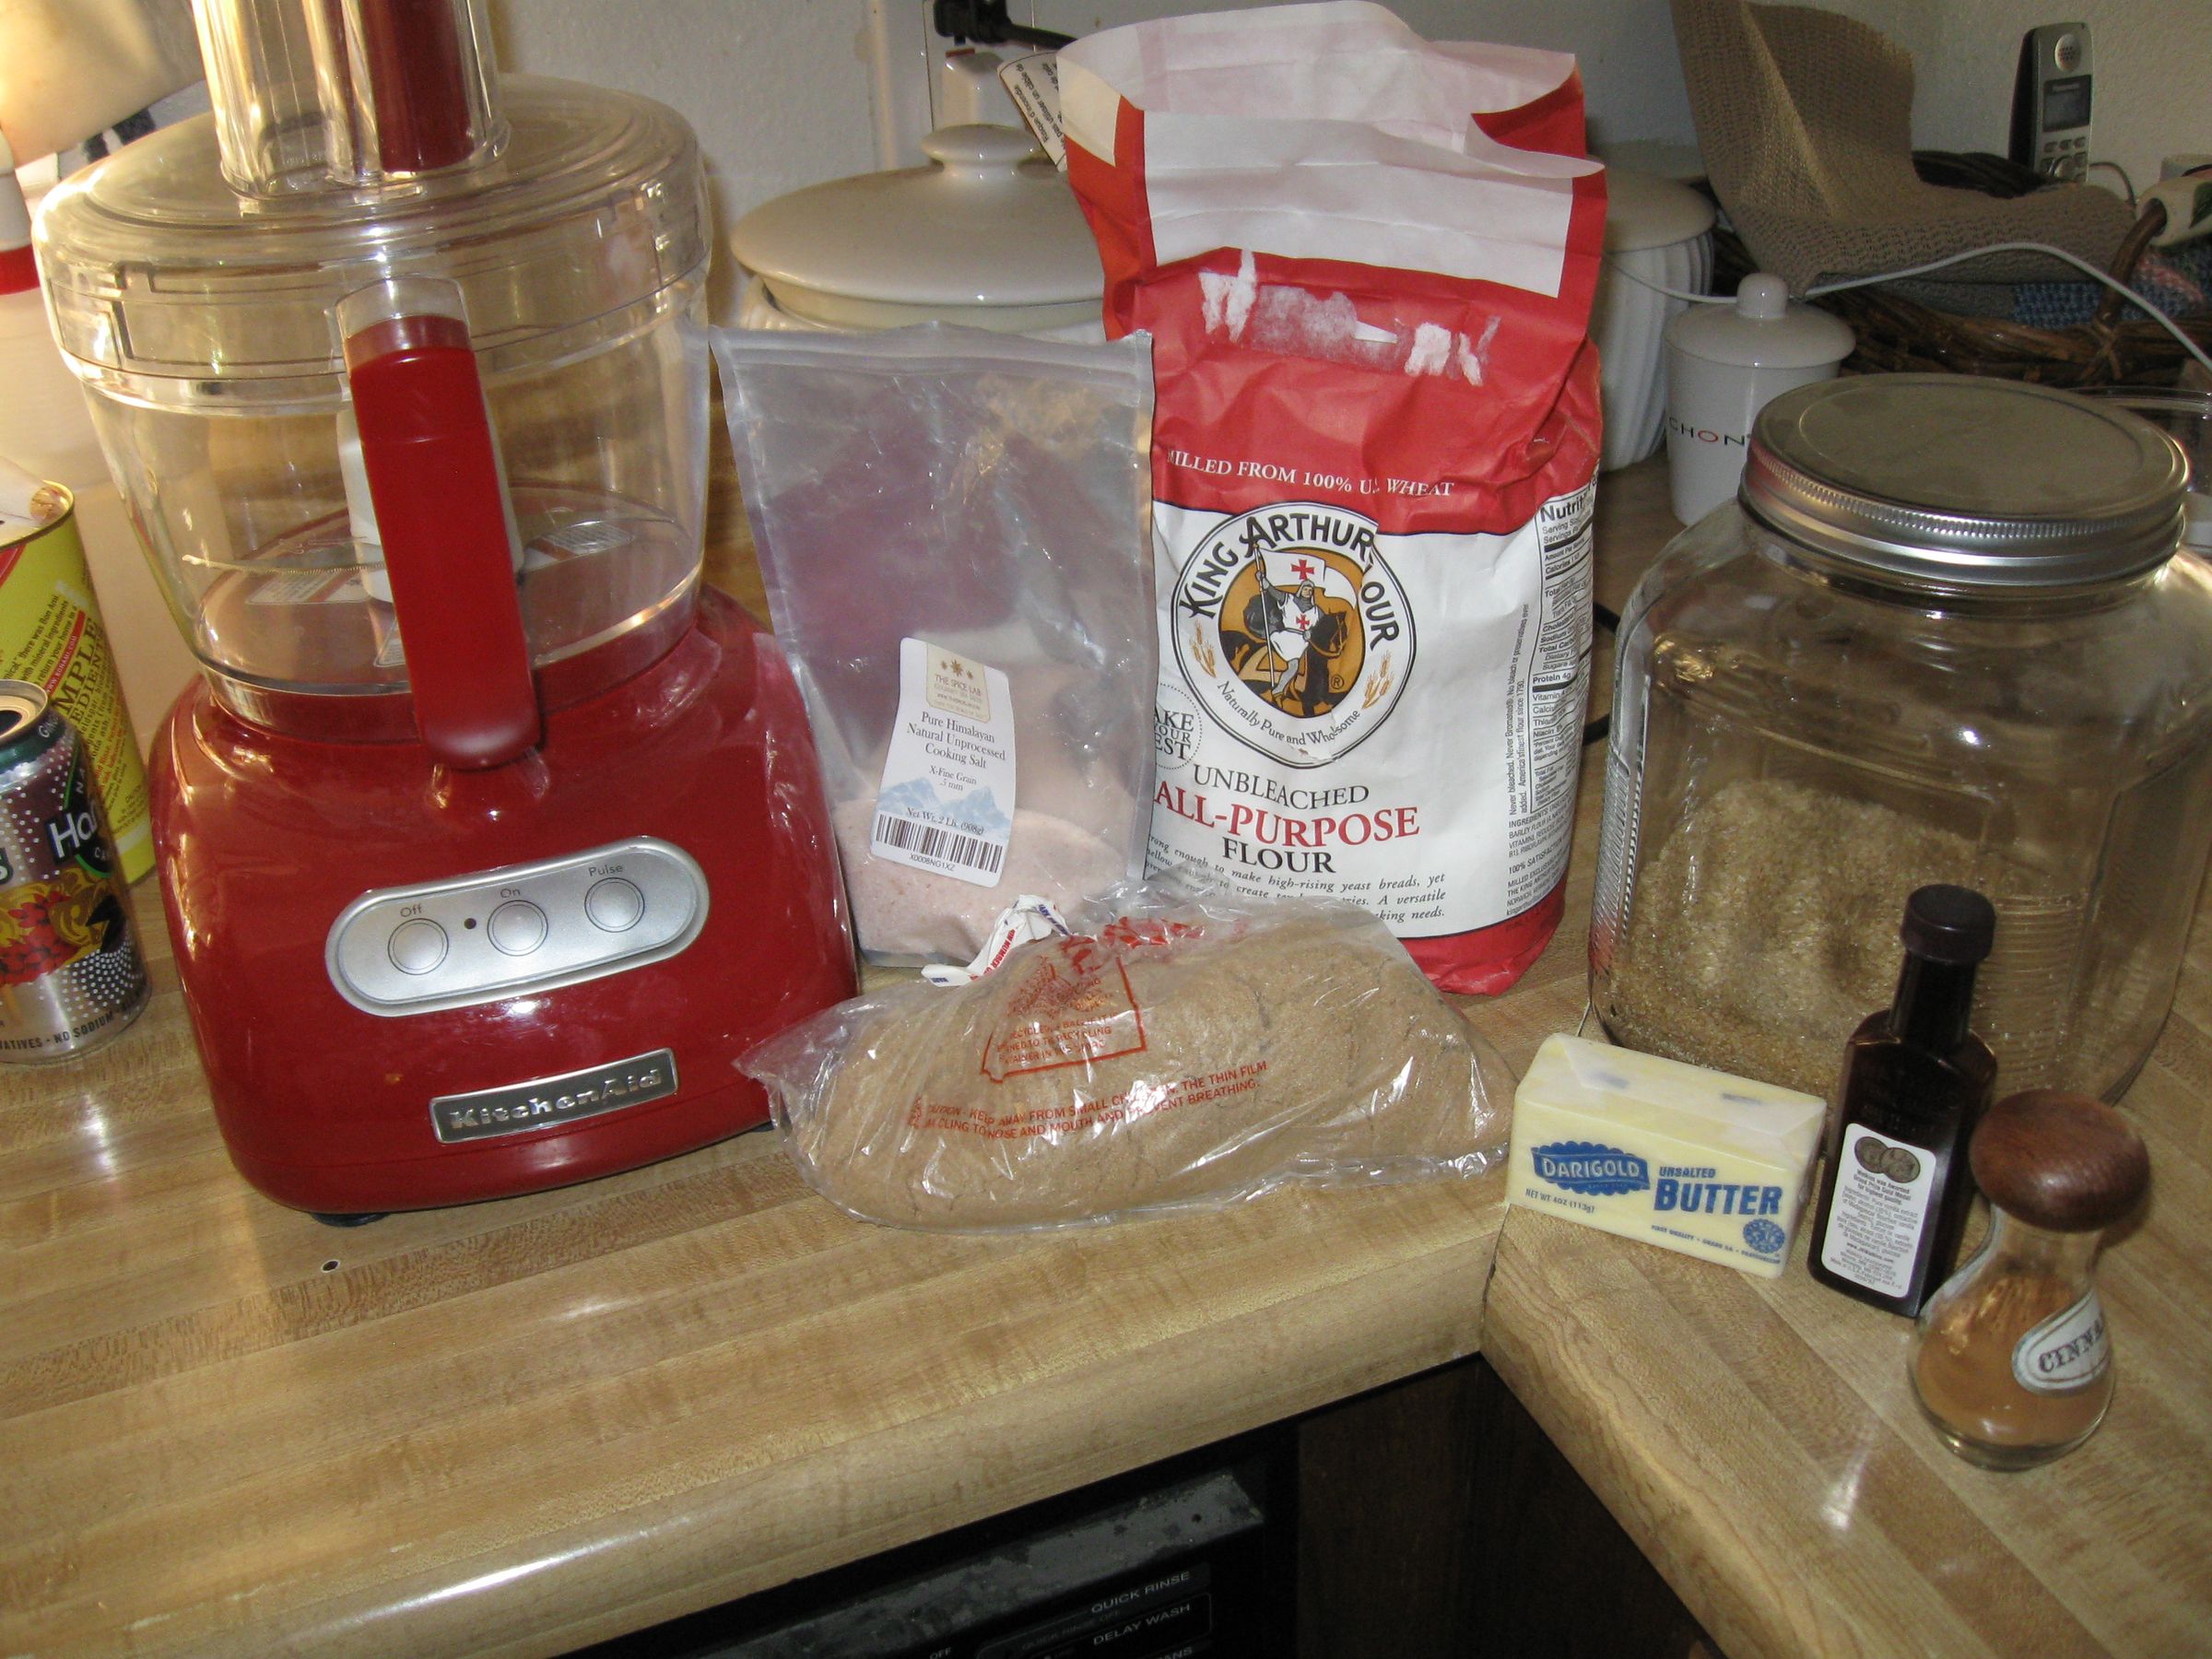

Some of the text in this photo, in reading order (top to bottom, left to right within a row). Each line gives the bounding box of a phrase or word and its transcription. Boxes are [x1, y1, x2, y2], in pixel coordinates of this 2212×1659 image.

[1669, 418, 1746, 447] CHON
[1237, 462, 1297, 484] FROM
[1303, 472, 1352, 492] 100%
[1386, 478, 1453, 496] WHEAT
[1177, 512, 1376, 620] KING ARTHUR
[32, 629, 42, 643] was
[40, 610, 51, 625] Bon
[1360, 579, 1400, 652] OUR
[31, 601, 68, 669] mineral ingredients
[38, 620, 73, 680] return your home
[935, 674, 948, 685] THE
[951, 679, 967, 691] SPICE
[969, 687, 981, 697] LAB
[1507, 664, 1517, 684] bleach
[1533, 675, 1560, 684] Protein
[1506, 685, 1514, 695] No
[1218, 681, 1260, 726] Naturally
[1261, 719, 1285, 741] Pure
[1287, 733, 1306, 746] and
[1516, 698, 1524, 715] since
[922, 711, 994, 744] Pure Himalayan
[1516, 716, 1524, 733] flour
[907, 723, 1006, 760] Natural Unprocessed
[1505, 737, 1514, 758] Never
[925, 743, 986, 769] Cooking Salt
[948, 782, 963, 792] mm
[957, 772, 977, 785] Grain
[1194, 765, 1370, 809] UNBLEACHED
[907, 807, 920, 818] Net
[1154, 780, 1420, 848] ALL-PURPOSE
[1508, 794, 1518, 816] Never
[1222, 837, 1336, 874] FLOUR
[588, 864, 624, 877] Pulse
[1174, 848, 1209, 868] enough
[1214, 865, 1225, 875] to
[1231, 869, 1262, 884] make
[1268, 875, 1335, 893] high-rising
[1340, 882, 1371, 893] yeast
[1379, 875, 1420, 889] breads,
[1429, 873, 1445, 887] yet
[500, 887, 520, 898] On
[1236, 885, 1269, 899] create
[1377, 888, 1446, 905] A versatile
[399, 903, 422, 918] Off
[1411, 906, 1445, 920] needs.
[991, 940, 1011, 969] NUMBER
[53, 1030, 71, 1044] NO
[73, 1011, 113, 1039] SODIUM
[449, 1068, 664, 1128] KitchenAid
[1030, 1108, 1065, 1122] FROM
[1068, 1099, 1107, 1117] SMALL
[1181, 1077, 1206, 1090] THE
[1208, 1070, 1238, 1085] THIN
[1241, 1060, 1268, 1077] FILM
[938, 1118, 969, 1132] CLING
[987, 1127, 1018, 1140] NOSE
[1020, 1124, 1046, 1137] AND
[1098, 1109, 1124, 1124] AND
[1187, 1077, 1260, 1106] BREATHING.
[1543, 1157, 1641, 1179] DARIGOLD
[1660, 1166, 1716, 1179] UNSALTED
[1525, 1188, 1538, 1199] NET
[1540, 1192, 1551, 1202] WT
[1653, 1179, 1783, 1217] BUTTER
[1091, 1571, 1191, 1614] QUICK RINSE
[1093, 1604, 1191, 1645] DELAY WASH
[929, 1647, 952, 1659] OFF
